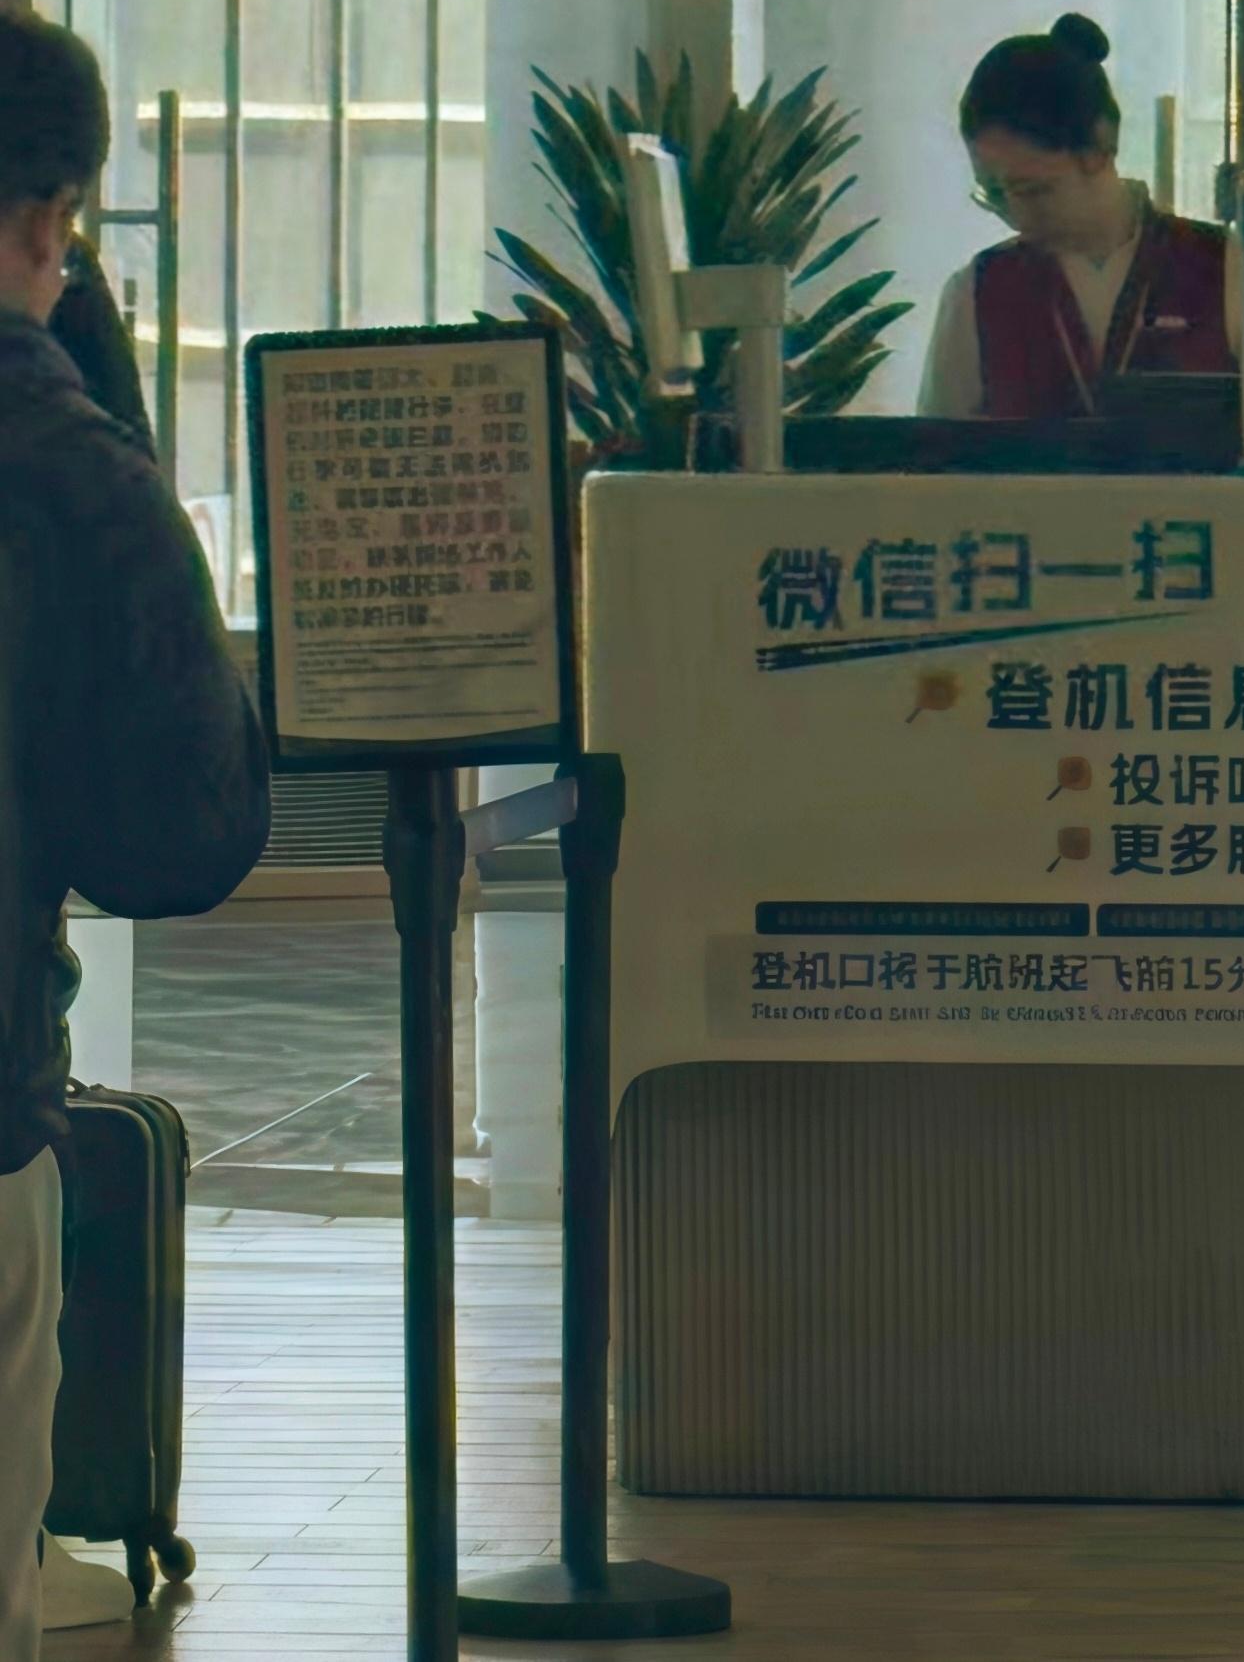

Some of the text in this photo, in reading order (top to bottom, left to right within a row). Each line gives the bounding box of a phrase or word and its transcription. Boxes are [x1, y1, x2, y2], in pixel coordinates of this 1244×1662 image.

[756, 520, 1214, 632] 微信扫一扫
